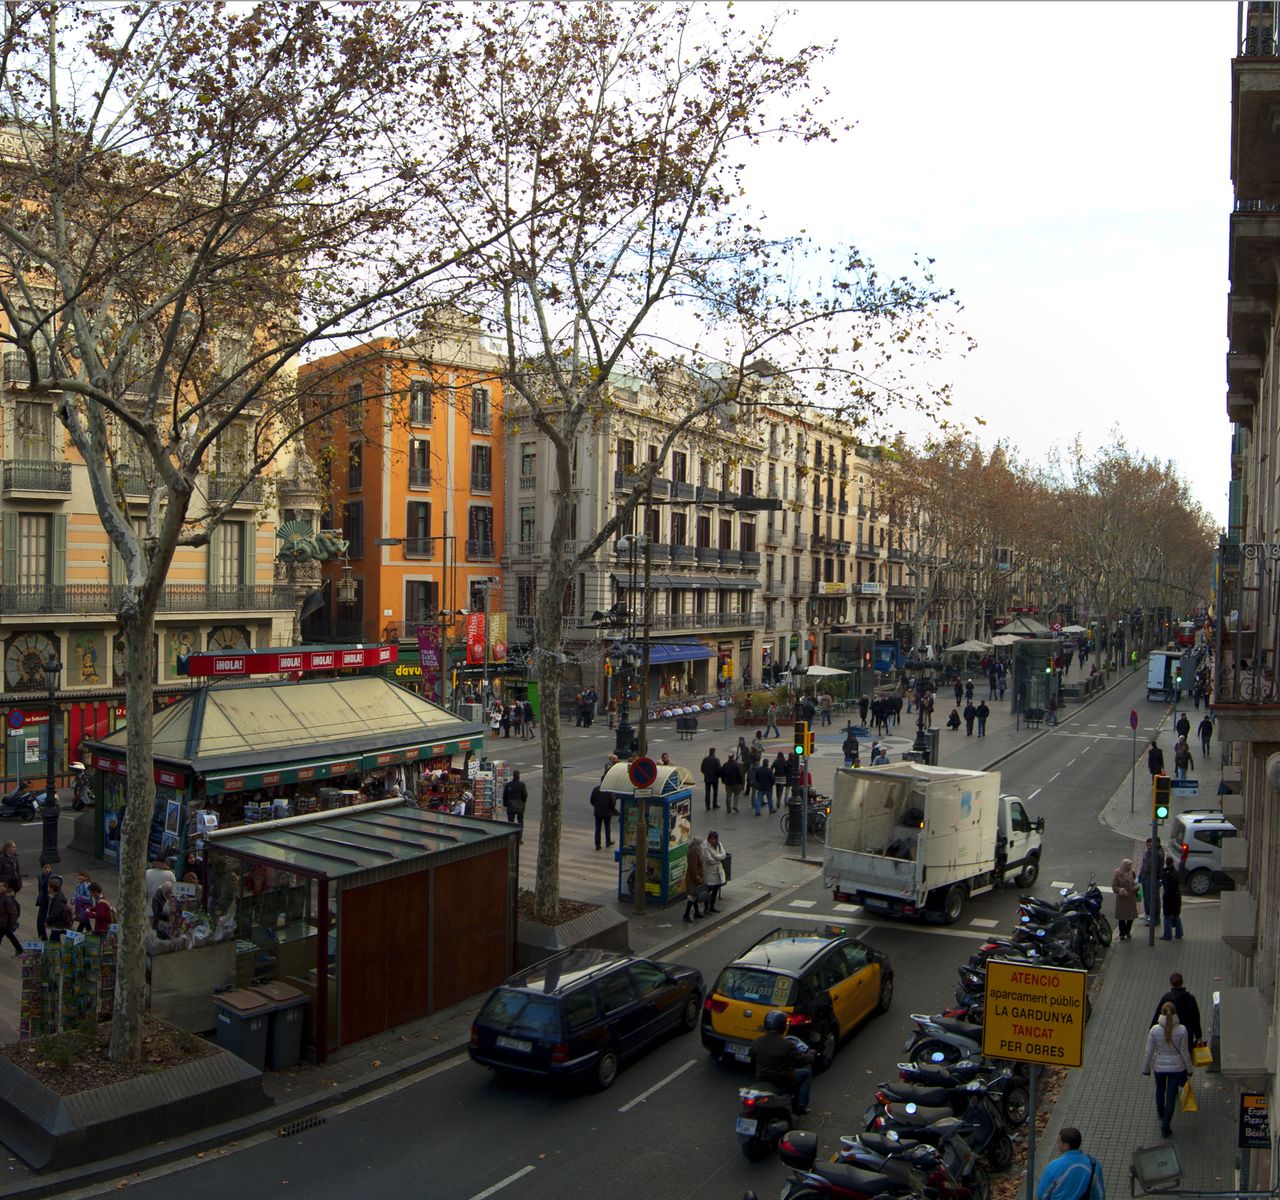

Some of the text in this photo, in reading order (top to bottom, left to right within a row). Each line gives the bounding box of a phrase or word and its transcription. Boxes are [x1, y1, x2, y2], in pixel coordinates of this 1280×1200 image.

[216, 660, 243, 670] ¡HOLA!
[1011, 971, 1060, 988] ATENCIÓ
[990, 989, 1080, 1008] aparcament públic
[995, 1005, 1073, 1024] LA GARDUNYA
[1012, 1024, 1055, 1039] TANCAT
[1000, 1040, 1065, 1058] PER OBRES
